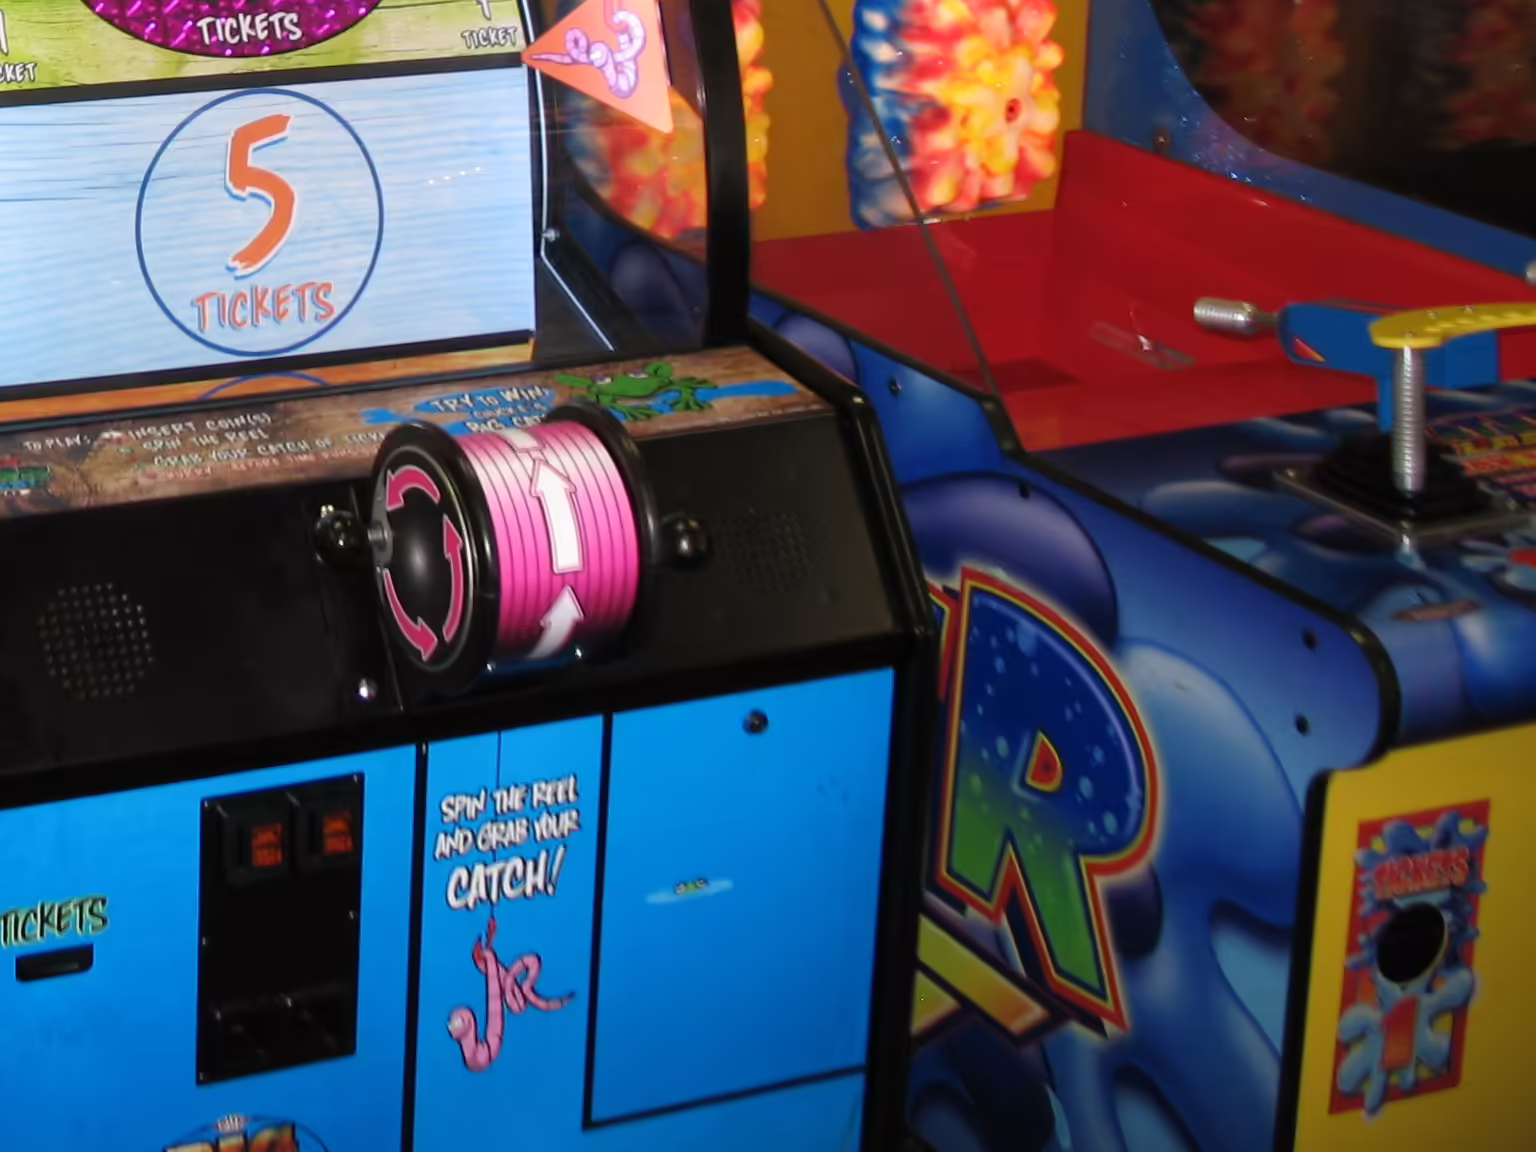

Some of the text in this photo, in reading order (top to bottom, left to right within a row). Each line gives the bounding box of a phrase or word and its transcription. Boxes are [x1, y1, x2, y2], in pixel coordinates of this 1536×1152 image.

[196, 12, 303, 48] TICKETS
[462, 26, 517, 50] TICKET
[224, 113, 298, 281] 5
[191, 281, 336, 333] TICKETS
[431, 394, 474, 413] TRY
[128, 412, 272, 441] INSERT COIN(S)
[143, 428, 269, 453] SPIN THE REEL
[153, 453, 202, 468] GRAB
[211, 448, 249, 462] YOUR
[257, 440, 310, 455] CATCH
[315, 437, 332, 449] OF
[440, 774, 578, 824] SPIN THE REEL
[434, 808, 580, 861] AND GRAB YOUR
[446, 845, 568, 911] CATCH!
